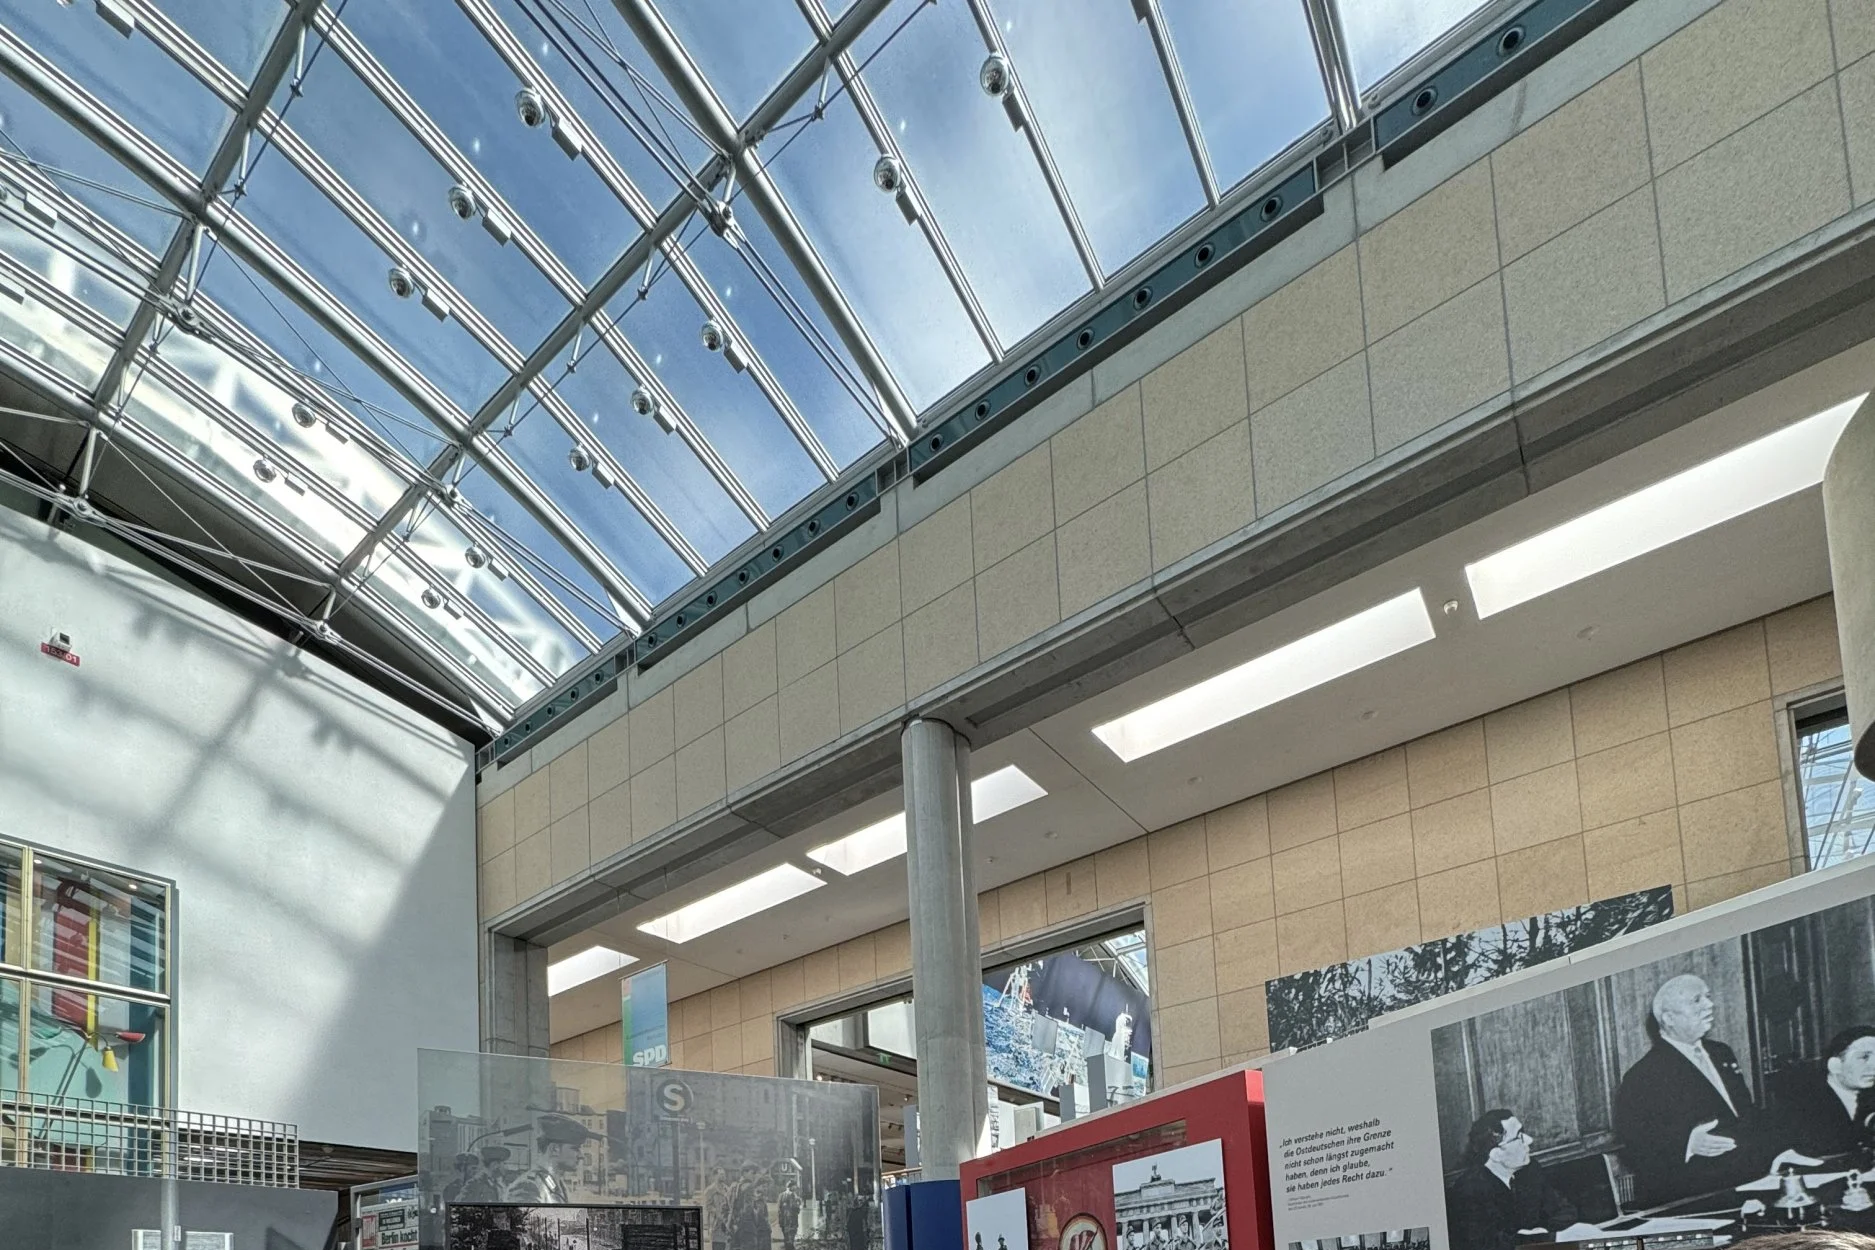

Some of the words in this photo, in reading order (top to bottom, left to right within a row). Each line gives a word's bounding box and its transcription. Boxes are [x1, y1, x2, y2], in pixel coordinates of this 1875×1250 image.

[632, 1044, 667, 1067] SPD
[663, 1083, 685, 1112] S
[1283, 1150, 1295, 1159] die
[1295, 1138, 1345, 1156] Ostdeutschen
[1346, 1136, 1362, 1146] ihre
[1363, 1129, 1392, 1142] Grenze
[1294, 1131, 1324, 1144] verstehe
[1325, 1126, 1346, 1138] nicht,
[1347, 1118, 1381, 1133] weshalb
[1284, 1160, 1302, 1170] nicht
[1303, 1155, 1324, 1167] schon
[1325, 1150, 1349, 1162] längst
[1350, 1141, 1395, 1157] zugemacht
[1310, 1167, 1328, 1177] denn
[1329, 1162, 1341, 1173] ich
[1342, 1159, 1371, 1173] glaube,
[1286, 1183, 1296, 1193] sie
[1297, 1179, 1319, 1191] haben
[1320, 1176, 1341, 1189] jedes
[1342, 1172, 1364, 1183] Recht
